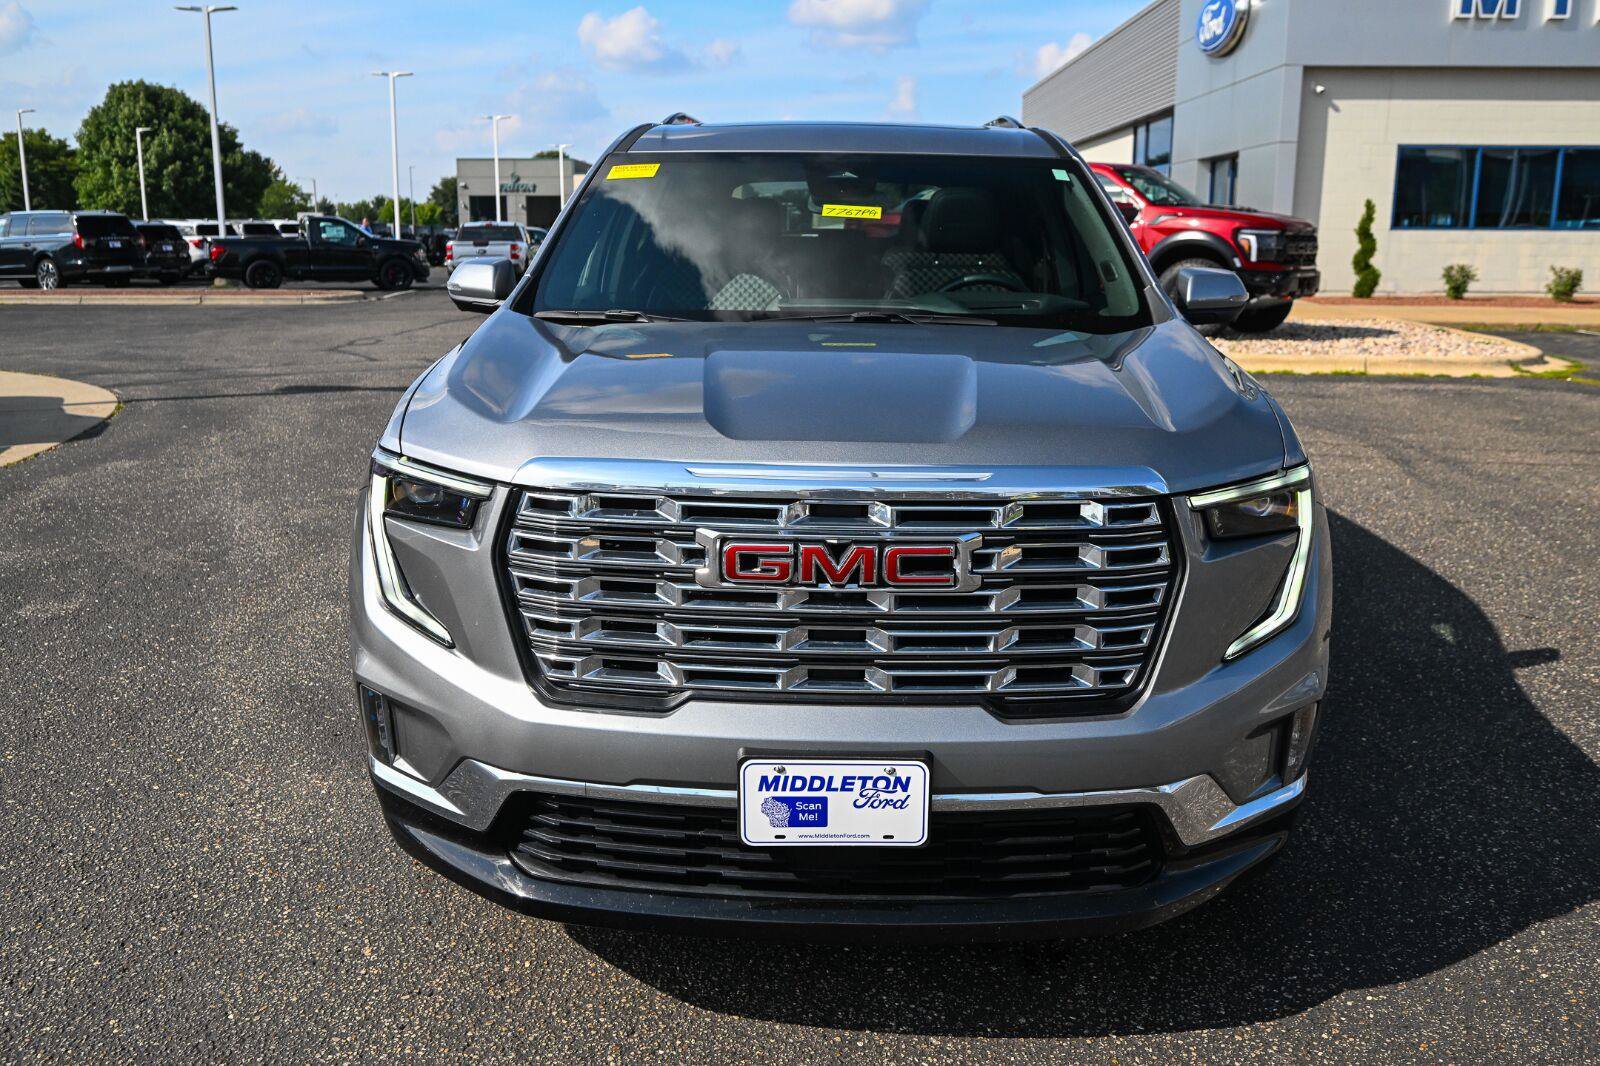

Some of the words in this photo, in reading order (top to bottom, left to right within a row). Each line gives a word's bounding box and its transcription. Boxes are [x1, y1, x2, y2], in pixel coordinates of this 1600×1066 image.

[1199, 1, 1227, 43] Ford
[723, 543, 955, 586] GMC
[758, 775, 911, 793] MIDDLETON
[795, 802, 822, 811] Scan
[852, 788, 911, 810] Ford
[798, 812, 818, 821] Me!
